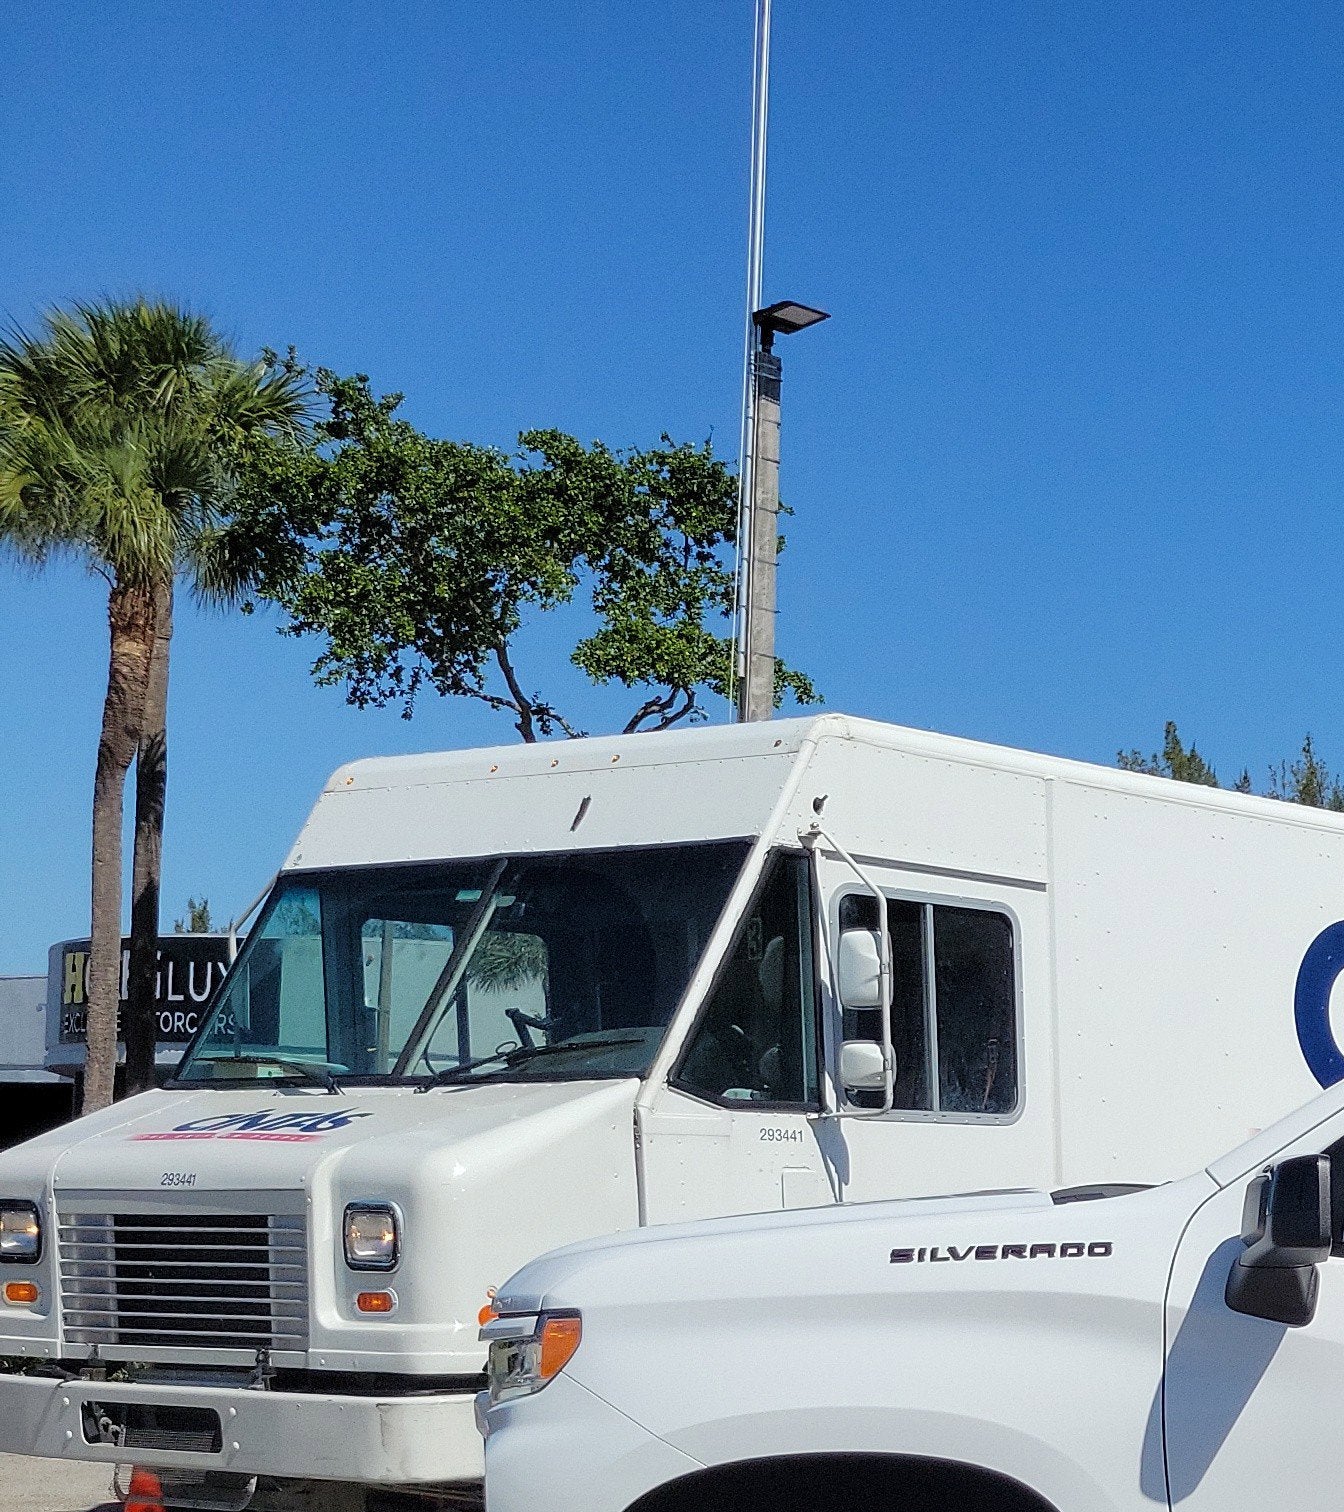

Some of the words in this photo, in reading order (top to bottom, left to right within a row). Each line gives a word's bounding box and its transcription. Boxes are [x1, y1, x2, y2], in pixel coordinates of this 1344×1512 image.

[759, 1127, 803, 1143] 293441
[160, 1172, 197, 1187] 293441
[889, 1241, 1114, 1264] SILVERADO
